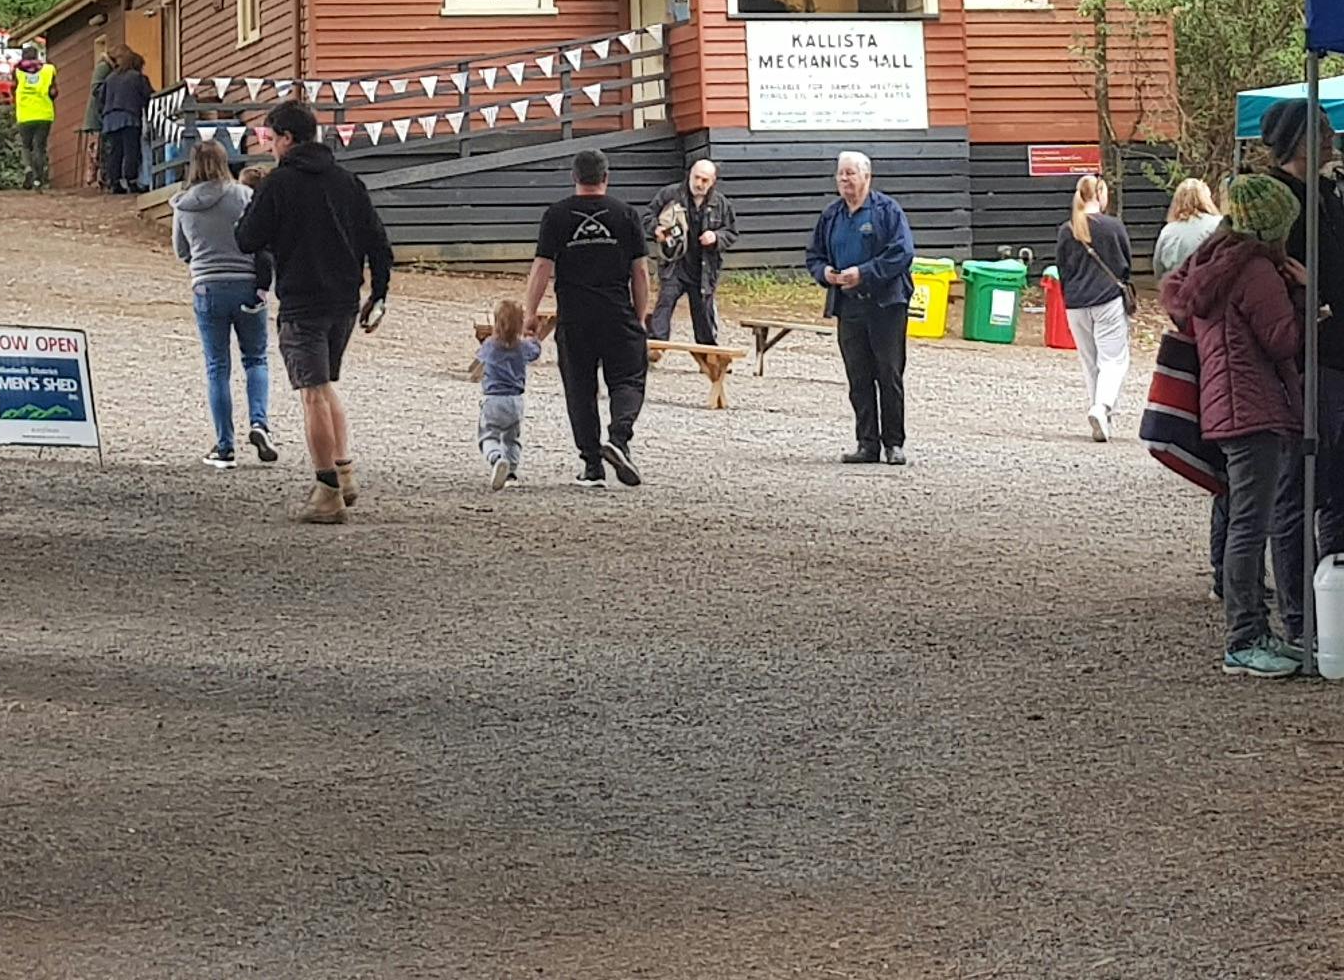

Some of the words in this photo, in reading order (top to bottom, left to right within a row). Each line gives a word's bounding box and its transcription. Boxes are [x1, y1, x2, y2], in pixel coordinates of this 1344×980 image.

[792, 34, 878, 48] KALLISTA
[759, 54, 859, 69] MECHANICS
[868, 54, 913, 69] HALL
[35, 336, 79, 353] OPEN
[42, 377, 78, 392] SHED
